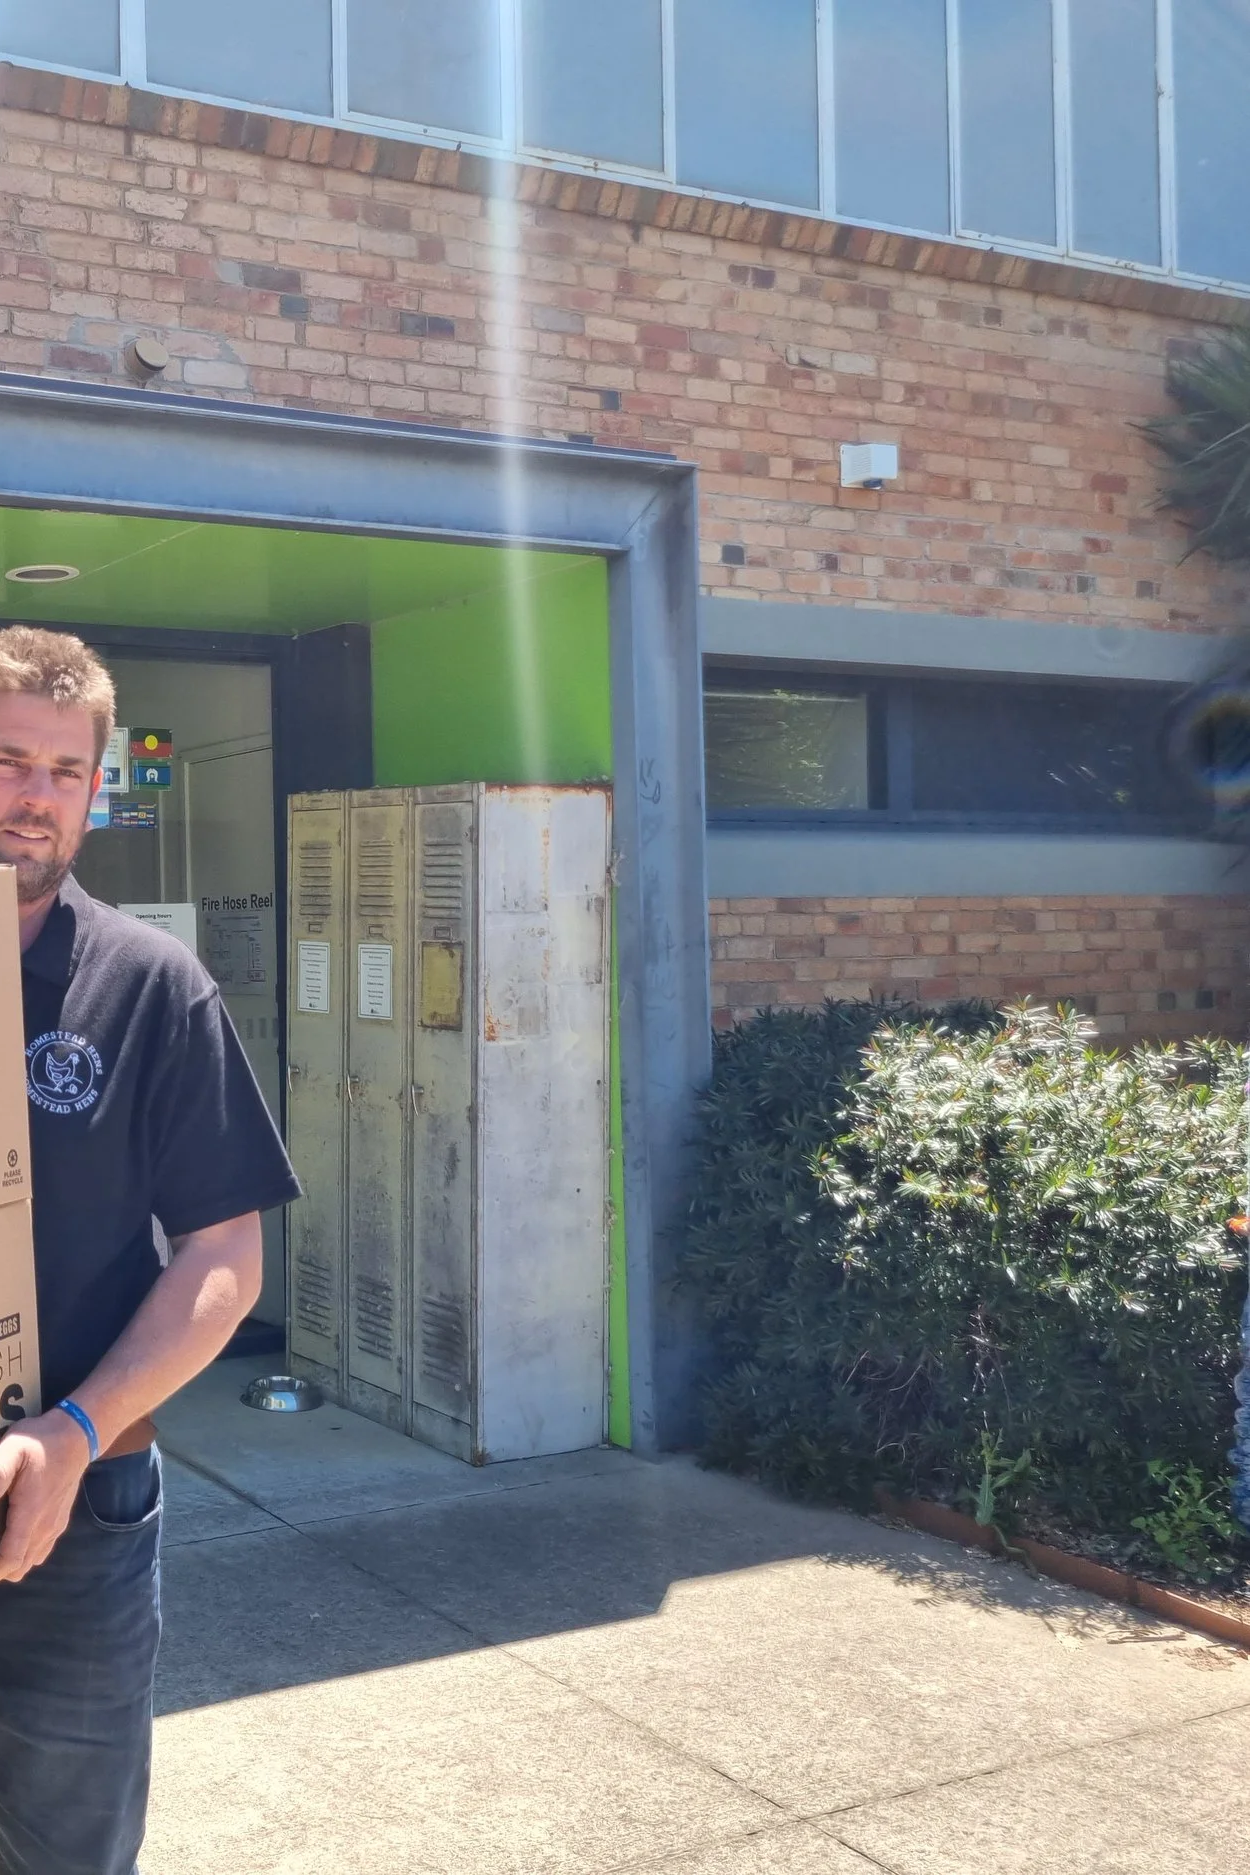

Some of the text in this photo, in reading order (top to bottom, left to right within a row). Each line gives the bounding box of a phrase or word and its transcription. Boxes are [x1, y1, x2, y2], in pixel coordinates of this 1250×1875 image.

[201, 892, 273, 912] Fire Hose Reel
[25, 1031, 103, 1075] HOMESTEAD HENS
[74, 1089, 99, 1111] HENS
[2, 1176, 23, 1187] RECYCLE
[4, 1169, 21, 1178] PLEASE
[0, 1317, 18, 1338] EGGS
